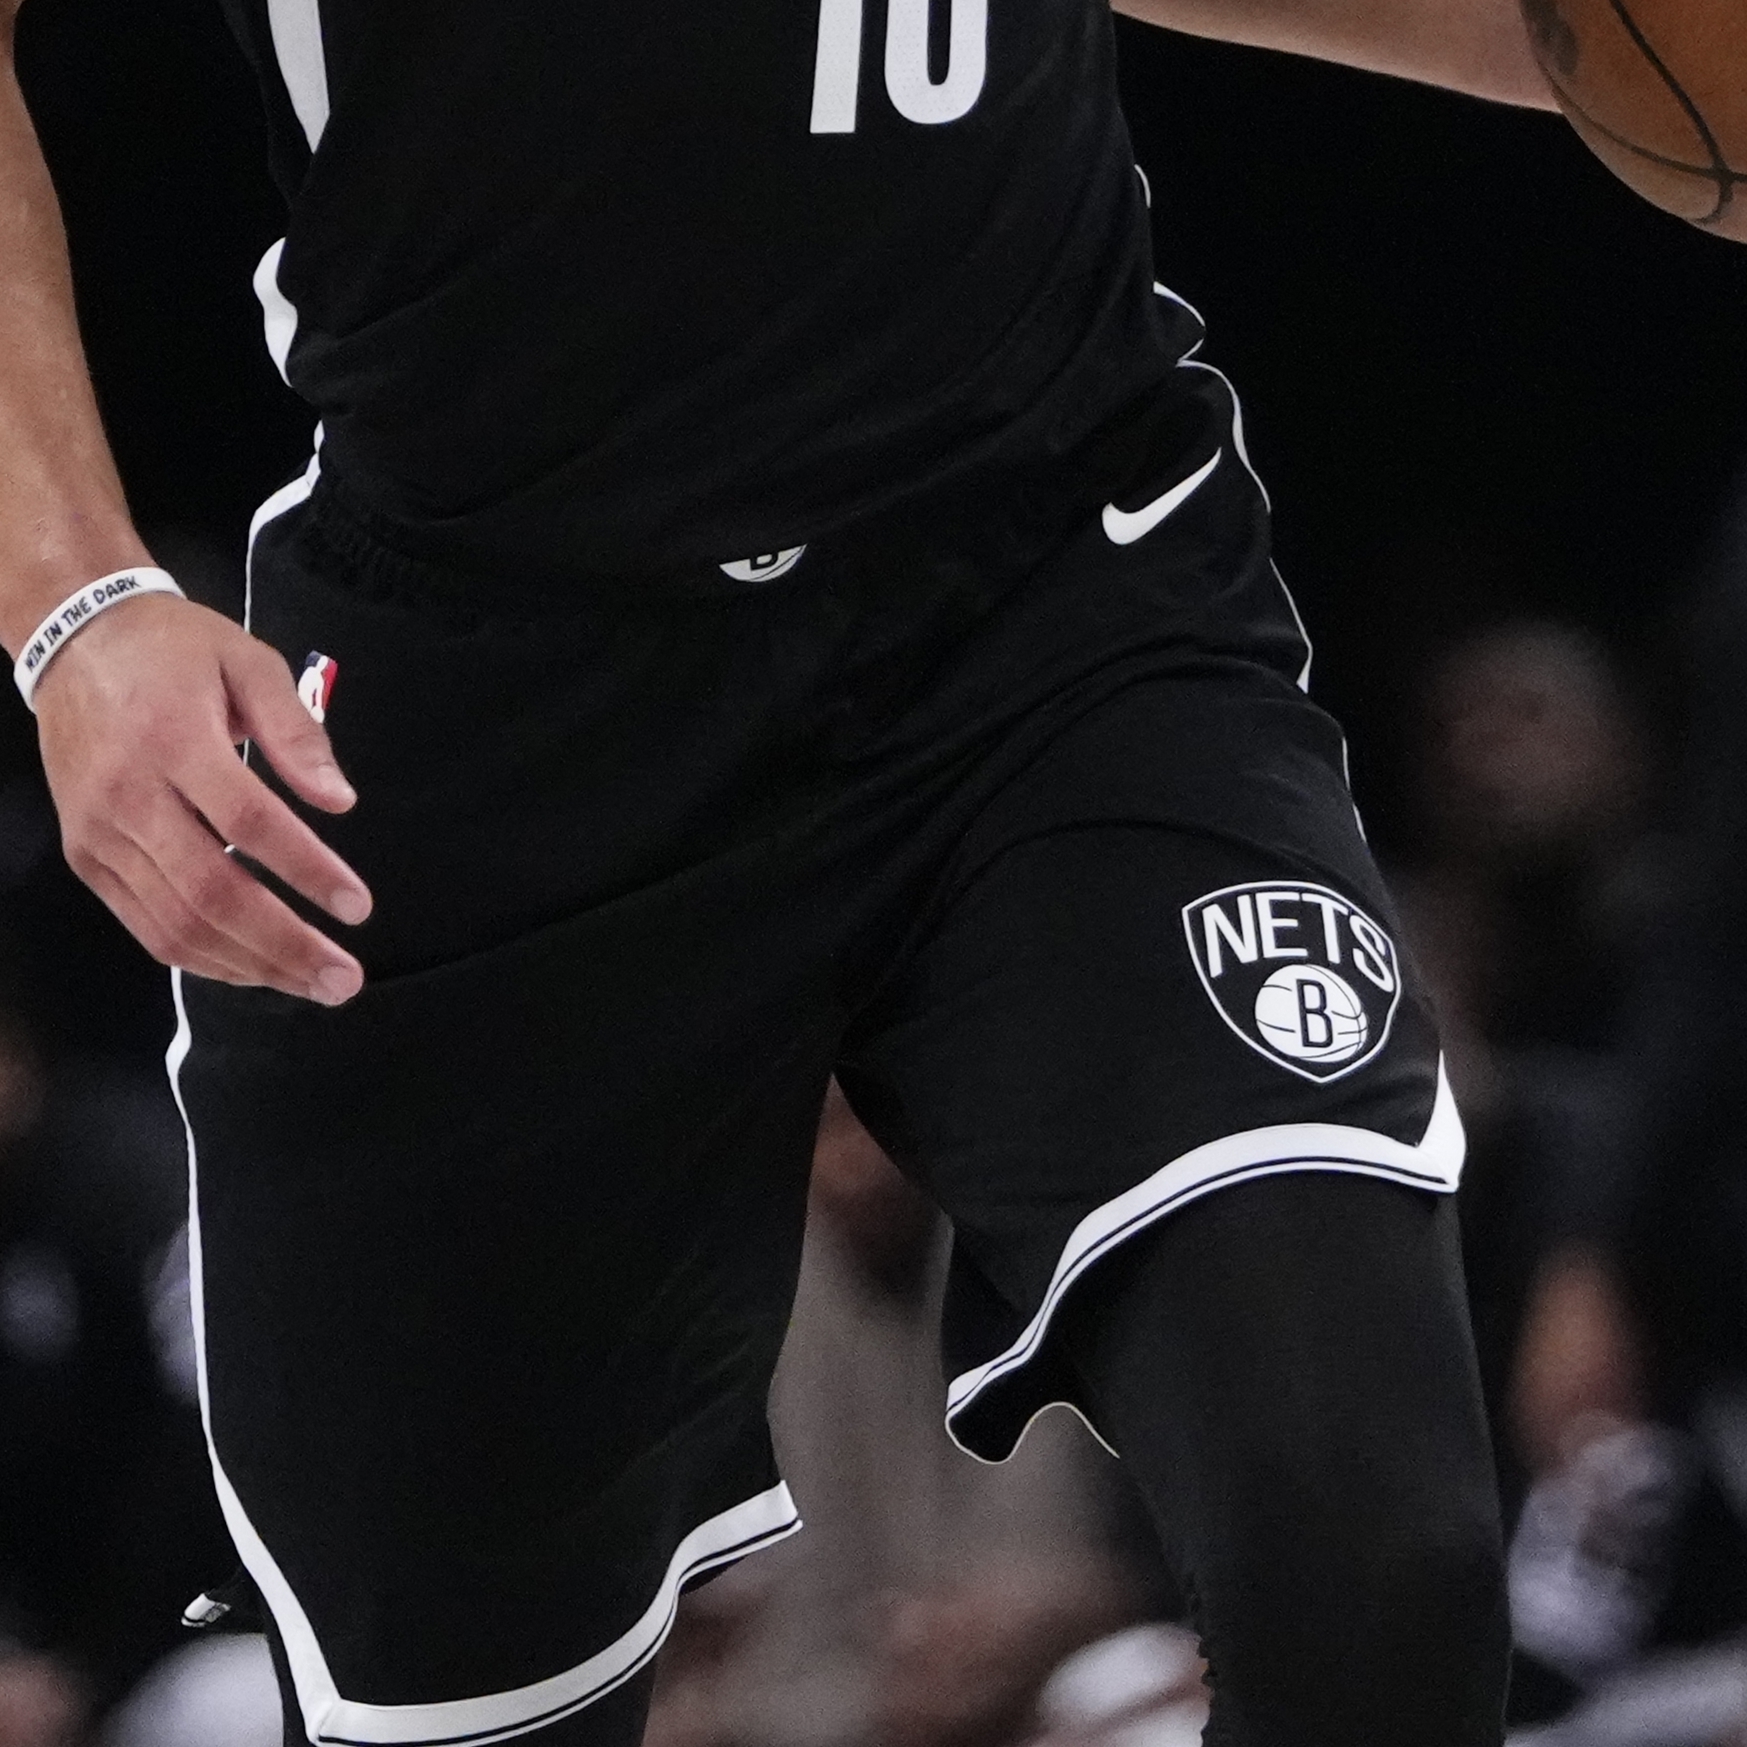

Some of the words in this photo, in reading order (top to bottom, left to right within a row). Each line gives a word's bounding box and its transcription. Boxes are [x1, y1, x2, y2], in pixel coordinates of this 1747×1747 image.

[43, 621, 63, 647] IN
[61, 596, 92, 627] THE
[92, 576, 142, 604] DARK
[1202, 891, 1394, 993] NETS
[1295, 978, 1334, 1048] B
